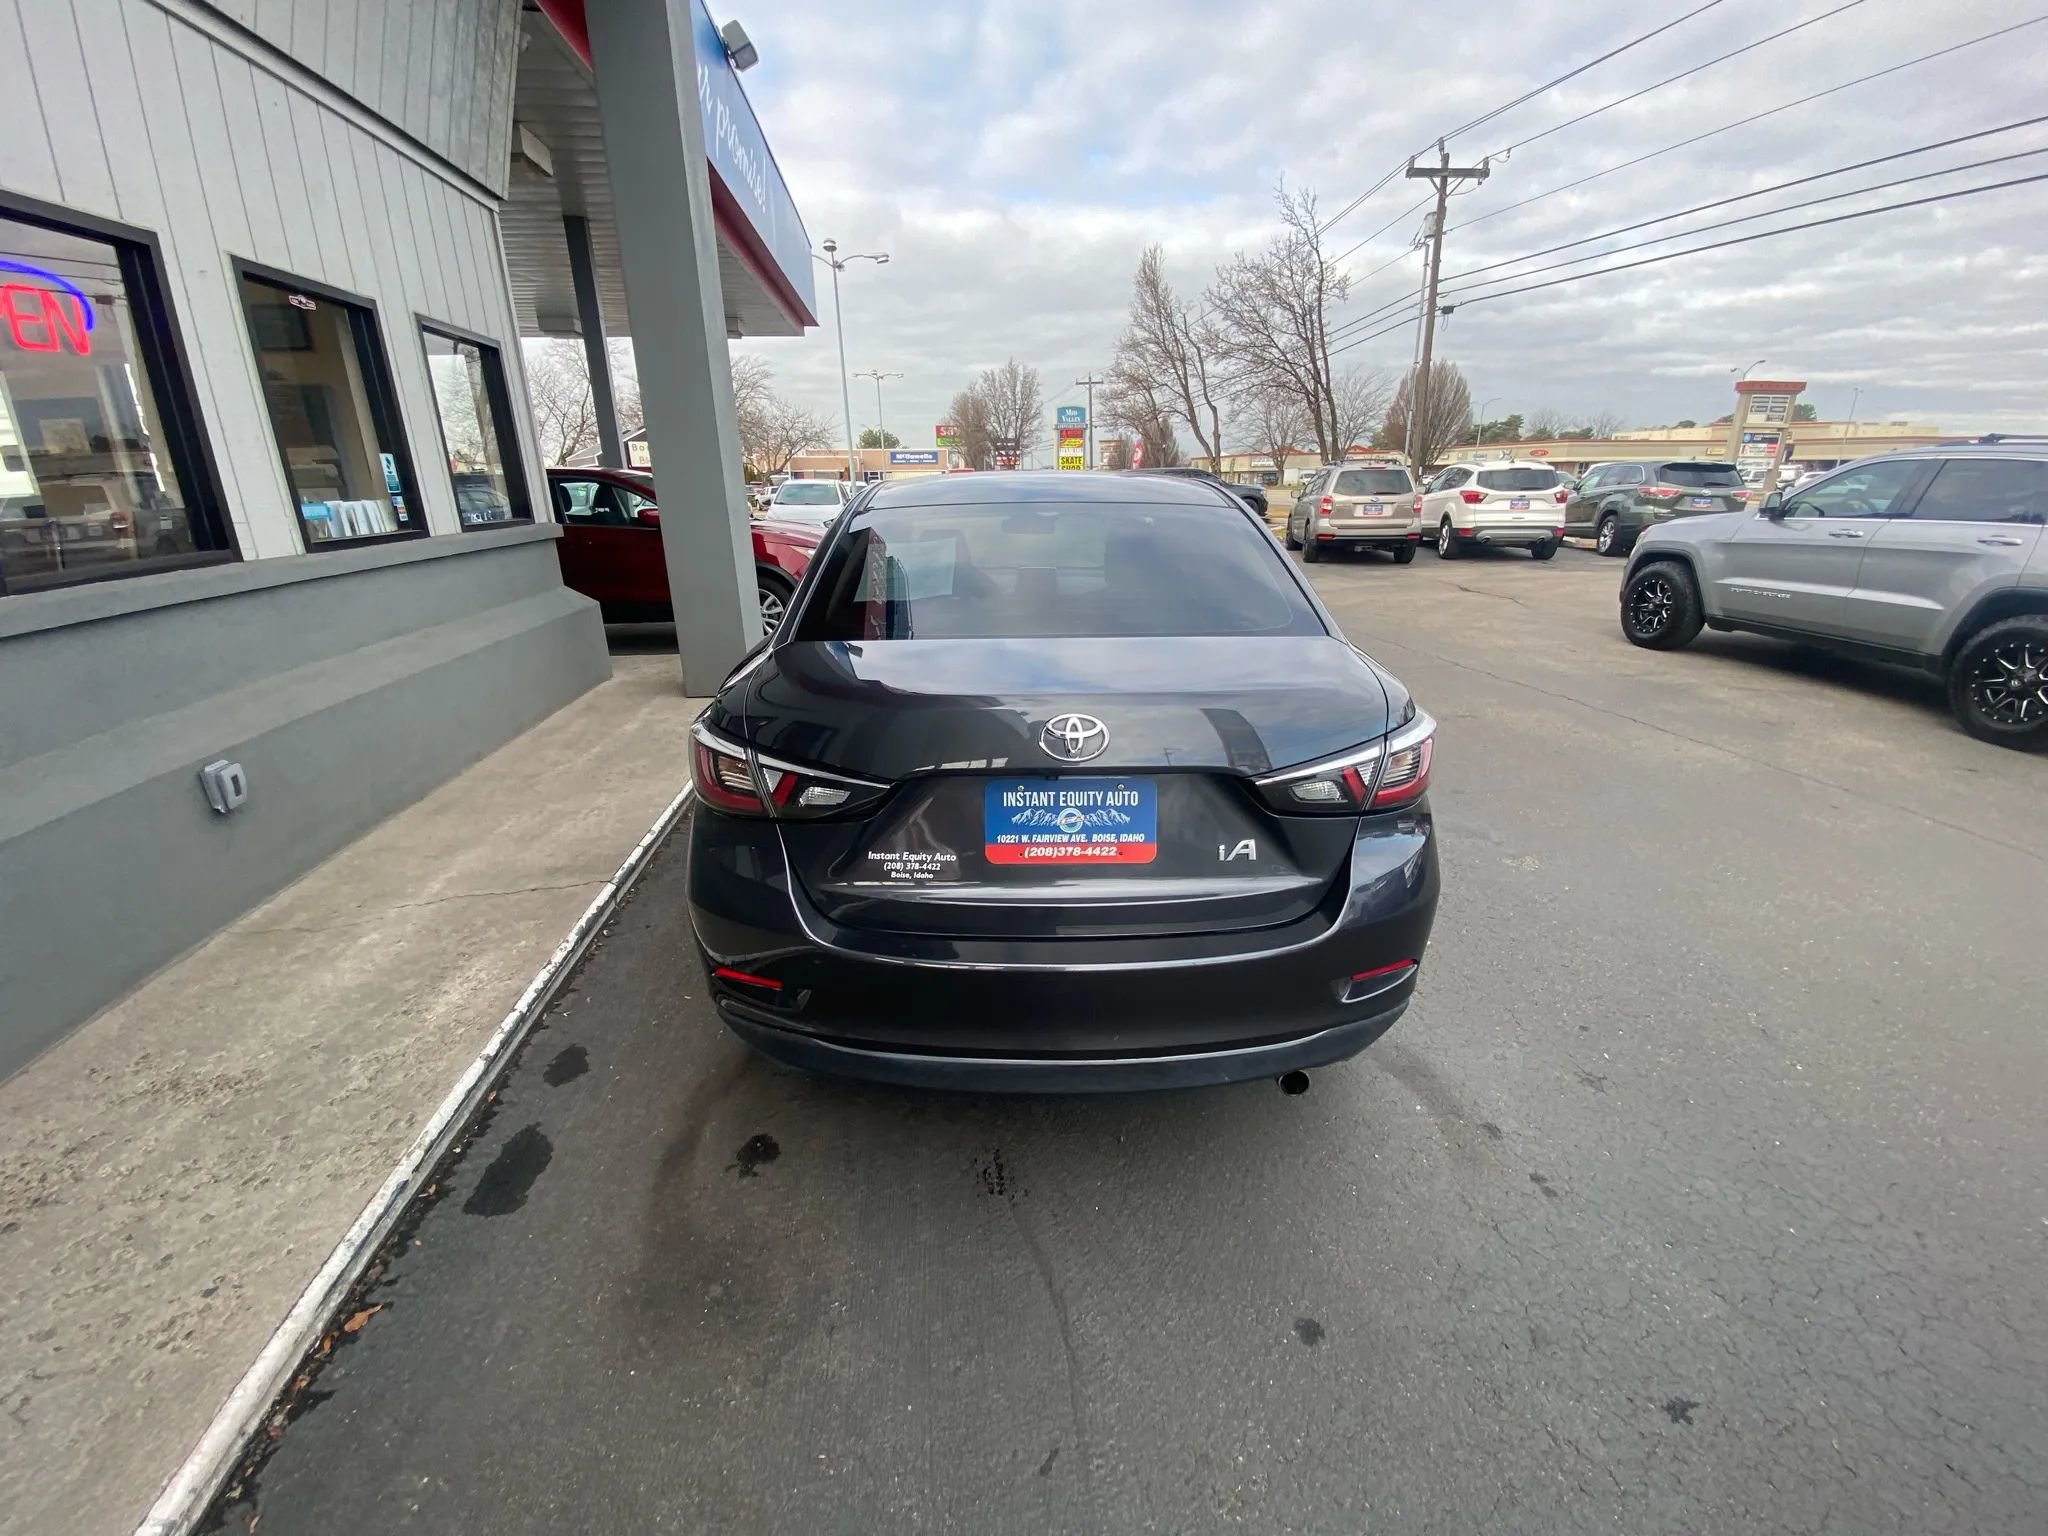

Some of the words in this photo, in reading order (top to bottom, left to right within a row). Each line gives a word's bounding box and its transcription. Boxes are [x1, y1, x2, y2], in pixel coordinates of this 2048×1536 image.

[0, 283, 91, 355] EN
[1060, 456, 1082, 465] SKATE
[1003, 791, 1056, 807] INSTANT
[1059, 791, 1103, 807] EQUITY
[1105, 791, 1139, 807] AUTO
[996, 834, 1019, 843] 10221
[1021, 835, 1030, 843] W.
[1031, 834, 1069, 843] FAIRVIEW
[1070, 834, 1088, 843] AVE.
[1091, 834, 1118, 844] BOISE,
[1119, 833, 1145, 843] IDAHO
[1024, 846, 1117, 858] (208)378-4422
[1218, 839, 1257, 861] iA
[868, 851, 900, 860] Instant
[902, 851, 932, 863] Equity
[934, 852, 957, 861] Auto
[883, 862, 904, 871] (208)
[905, 862, 941, 871] 378-4422
[890, 871, 912, 879] Boise,
[913, 871, 934, 879] Idaho
